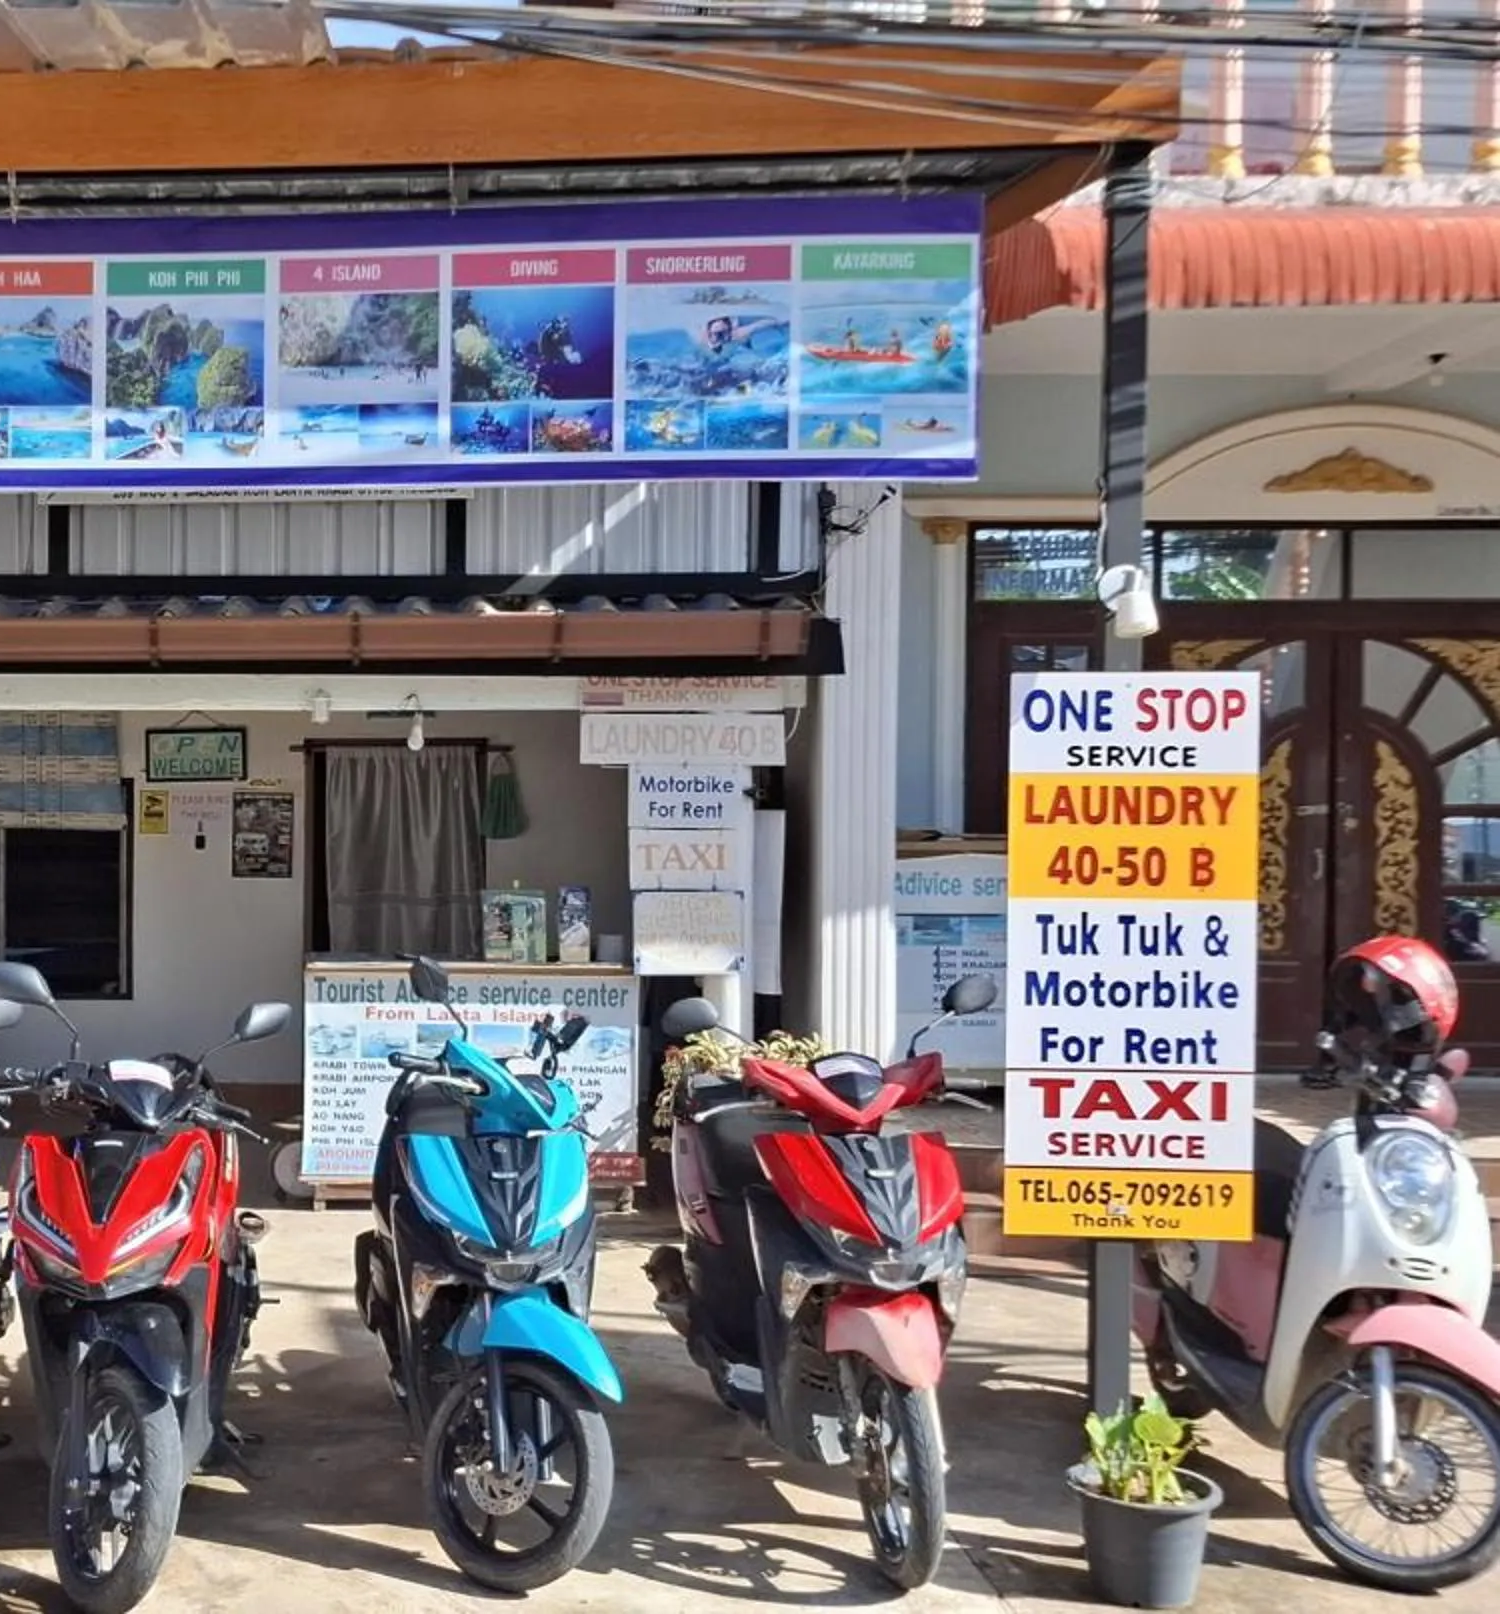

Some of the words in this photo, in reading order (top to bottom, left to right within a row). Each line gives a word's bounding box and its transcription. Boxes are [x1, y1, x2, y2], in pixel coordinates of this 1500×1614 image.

[312, 265, 324, 281] 4
[332, 263, 382, 281] ISLAND
[510, 259, 559, 278] DIVING
[645, 255, 745, 276] SNORKERLING
[13, 270, 41, 287] HAA
[148, 270, 177, 288] KOH
[185, 270, 209, 287] PHI
[217, 270, 241, 287] PHI
[692, 676, 776, 688] SERVICE
[628, 690, 690, 702] THANK
[697, 690, 732, 703] YOU
[1023, 689, 1114, 732] ONE
[1136, 688, 1247, 732] STOP
[587, 723, 714, 756] LAUNDRY
[153, 757, 240, 776] WELCOME
[1066, 745, 1197, 767] SERVICE
[639, 775, 735, 794] Motorbike
[649, 802, 676, 818] For
[682, 801, 723, 819] Rent
[1024, 784, 1238, 826] LAUNDRY
[636, 844, 728, 872] TAXI
[1047, 845, 1167, 887] 40-50
[1035, 912, 1100, 955] Tuk
[1117, 912, 1184, 956] Tuk
[1203, 915, 1229, 957] &
[314, 976, 385, 1004] Tourist
[479, 979, 549, 1006] service
[563, 979, 629, 1009] center
[1024, 970, 1239, 1009] Motorbike
[365, 1006, 415, 1021] From
[1040, 1027, 1103, 1063] For
[1124, 1027, 1218, 1065] Rent
[353, 1062, 387, 1070] TOWN
[1029, 1077, 1228, 1121] TAXI
[333, 1112, 365, 1121] NANG
[1048, 1132, 1206, 1159] SERVICE
[1019, 1179, 1235, 1208] TEL.065-7092619
[1073, 1212, 1135, 1230] Thank
[1144, 1213, 1181, 1230] You
